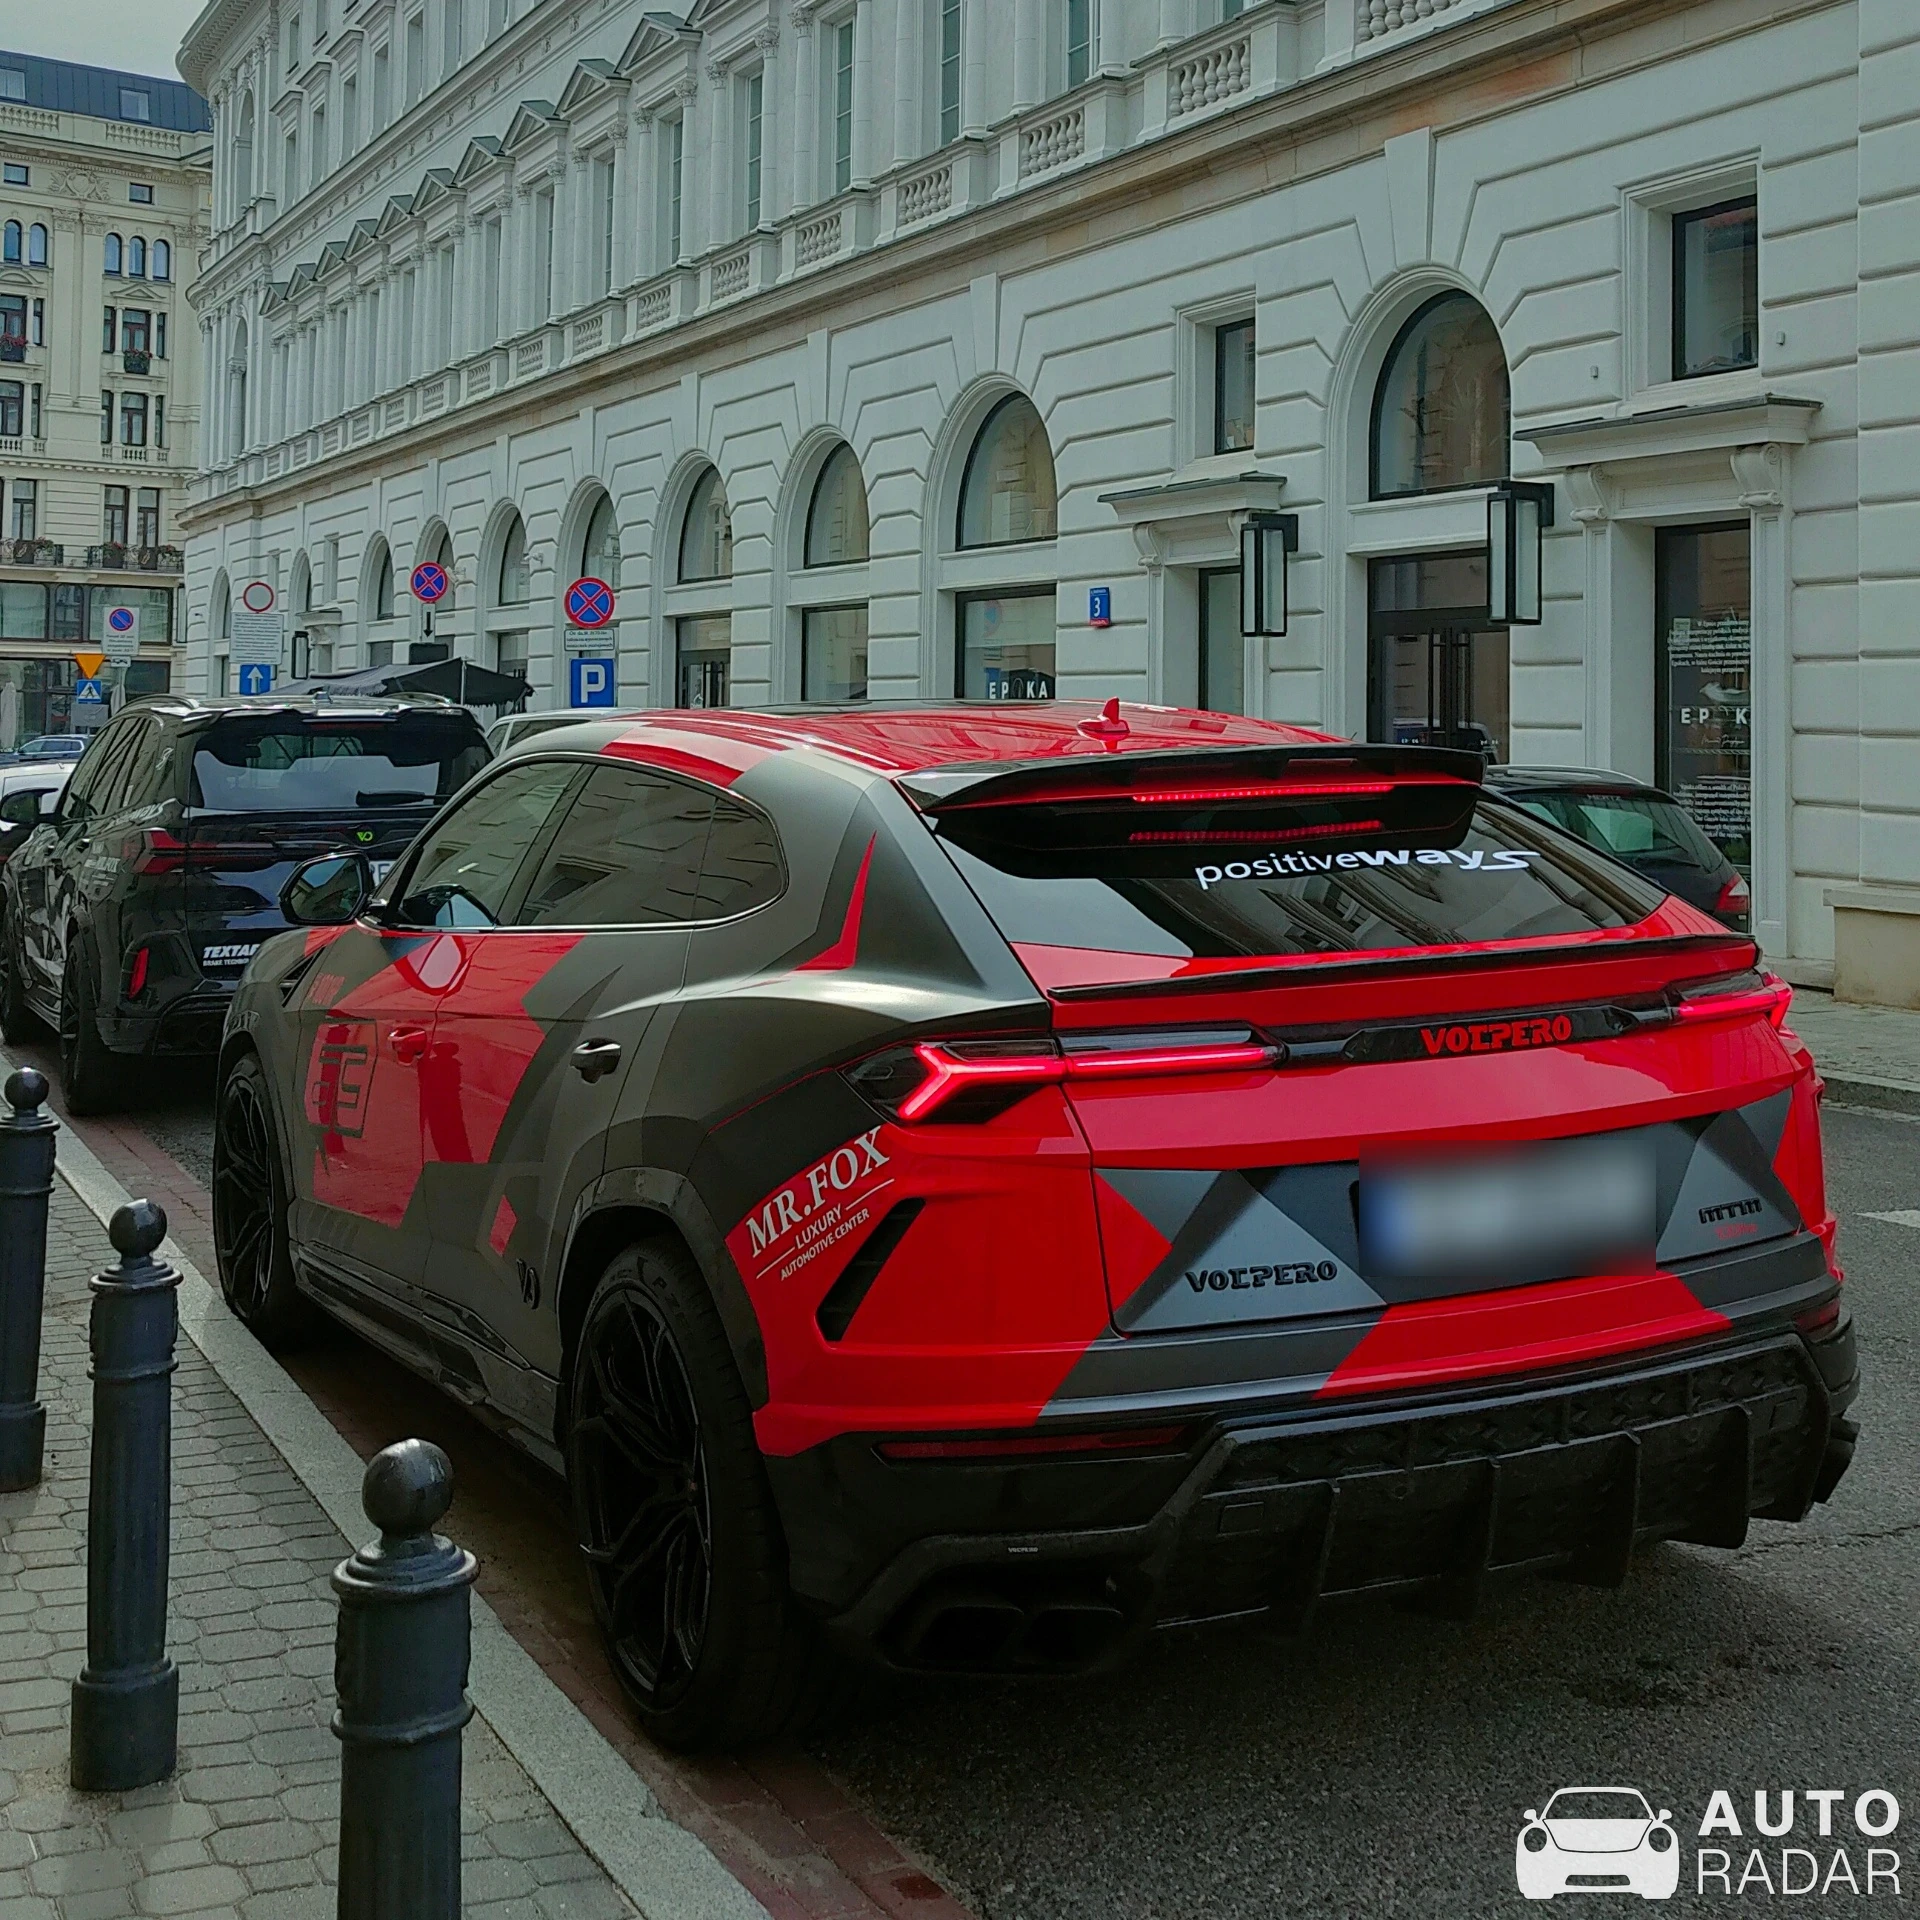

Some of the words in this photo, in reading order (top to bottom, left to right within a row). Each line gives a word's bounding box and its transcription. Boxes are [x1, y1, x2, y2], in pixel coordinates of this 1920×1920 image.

[1094, 597, 1101, 617] 3
[581, 664, 606, 704] P
[1194, 850, 1541, 890] positiveways
[780, 1232, 836, 1281] AUTOMOTIVE
[834, 1208, 870, 1240] CENTER
[795, 1203, 842, 1249] LUXURY
